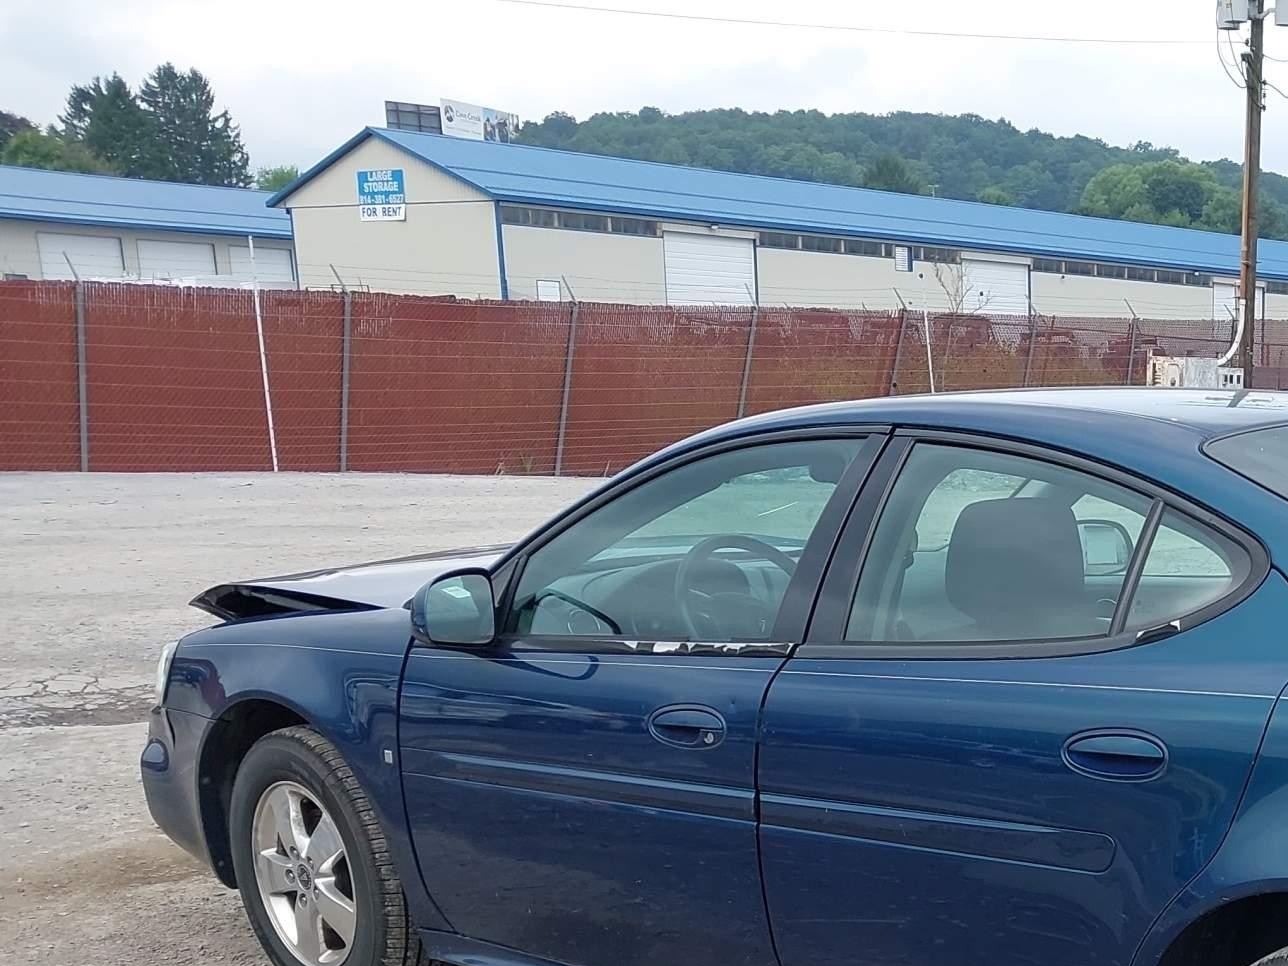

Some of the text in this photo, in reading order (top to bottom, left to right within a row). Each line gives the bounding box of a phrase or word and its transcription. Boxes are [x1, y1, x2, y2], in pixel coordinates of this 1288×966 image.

[367, 170, 392, 181] LARGE
[363, 180, 399, 193] STORAGE
[361, 206, 402, 217] FOR RENT
